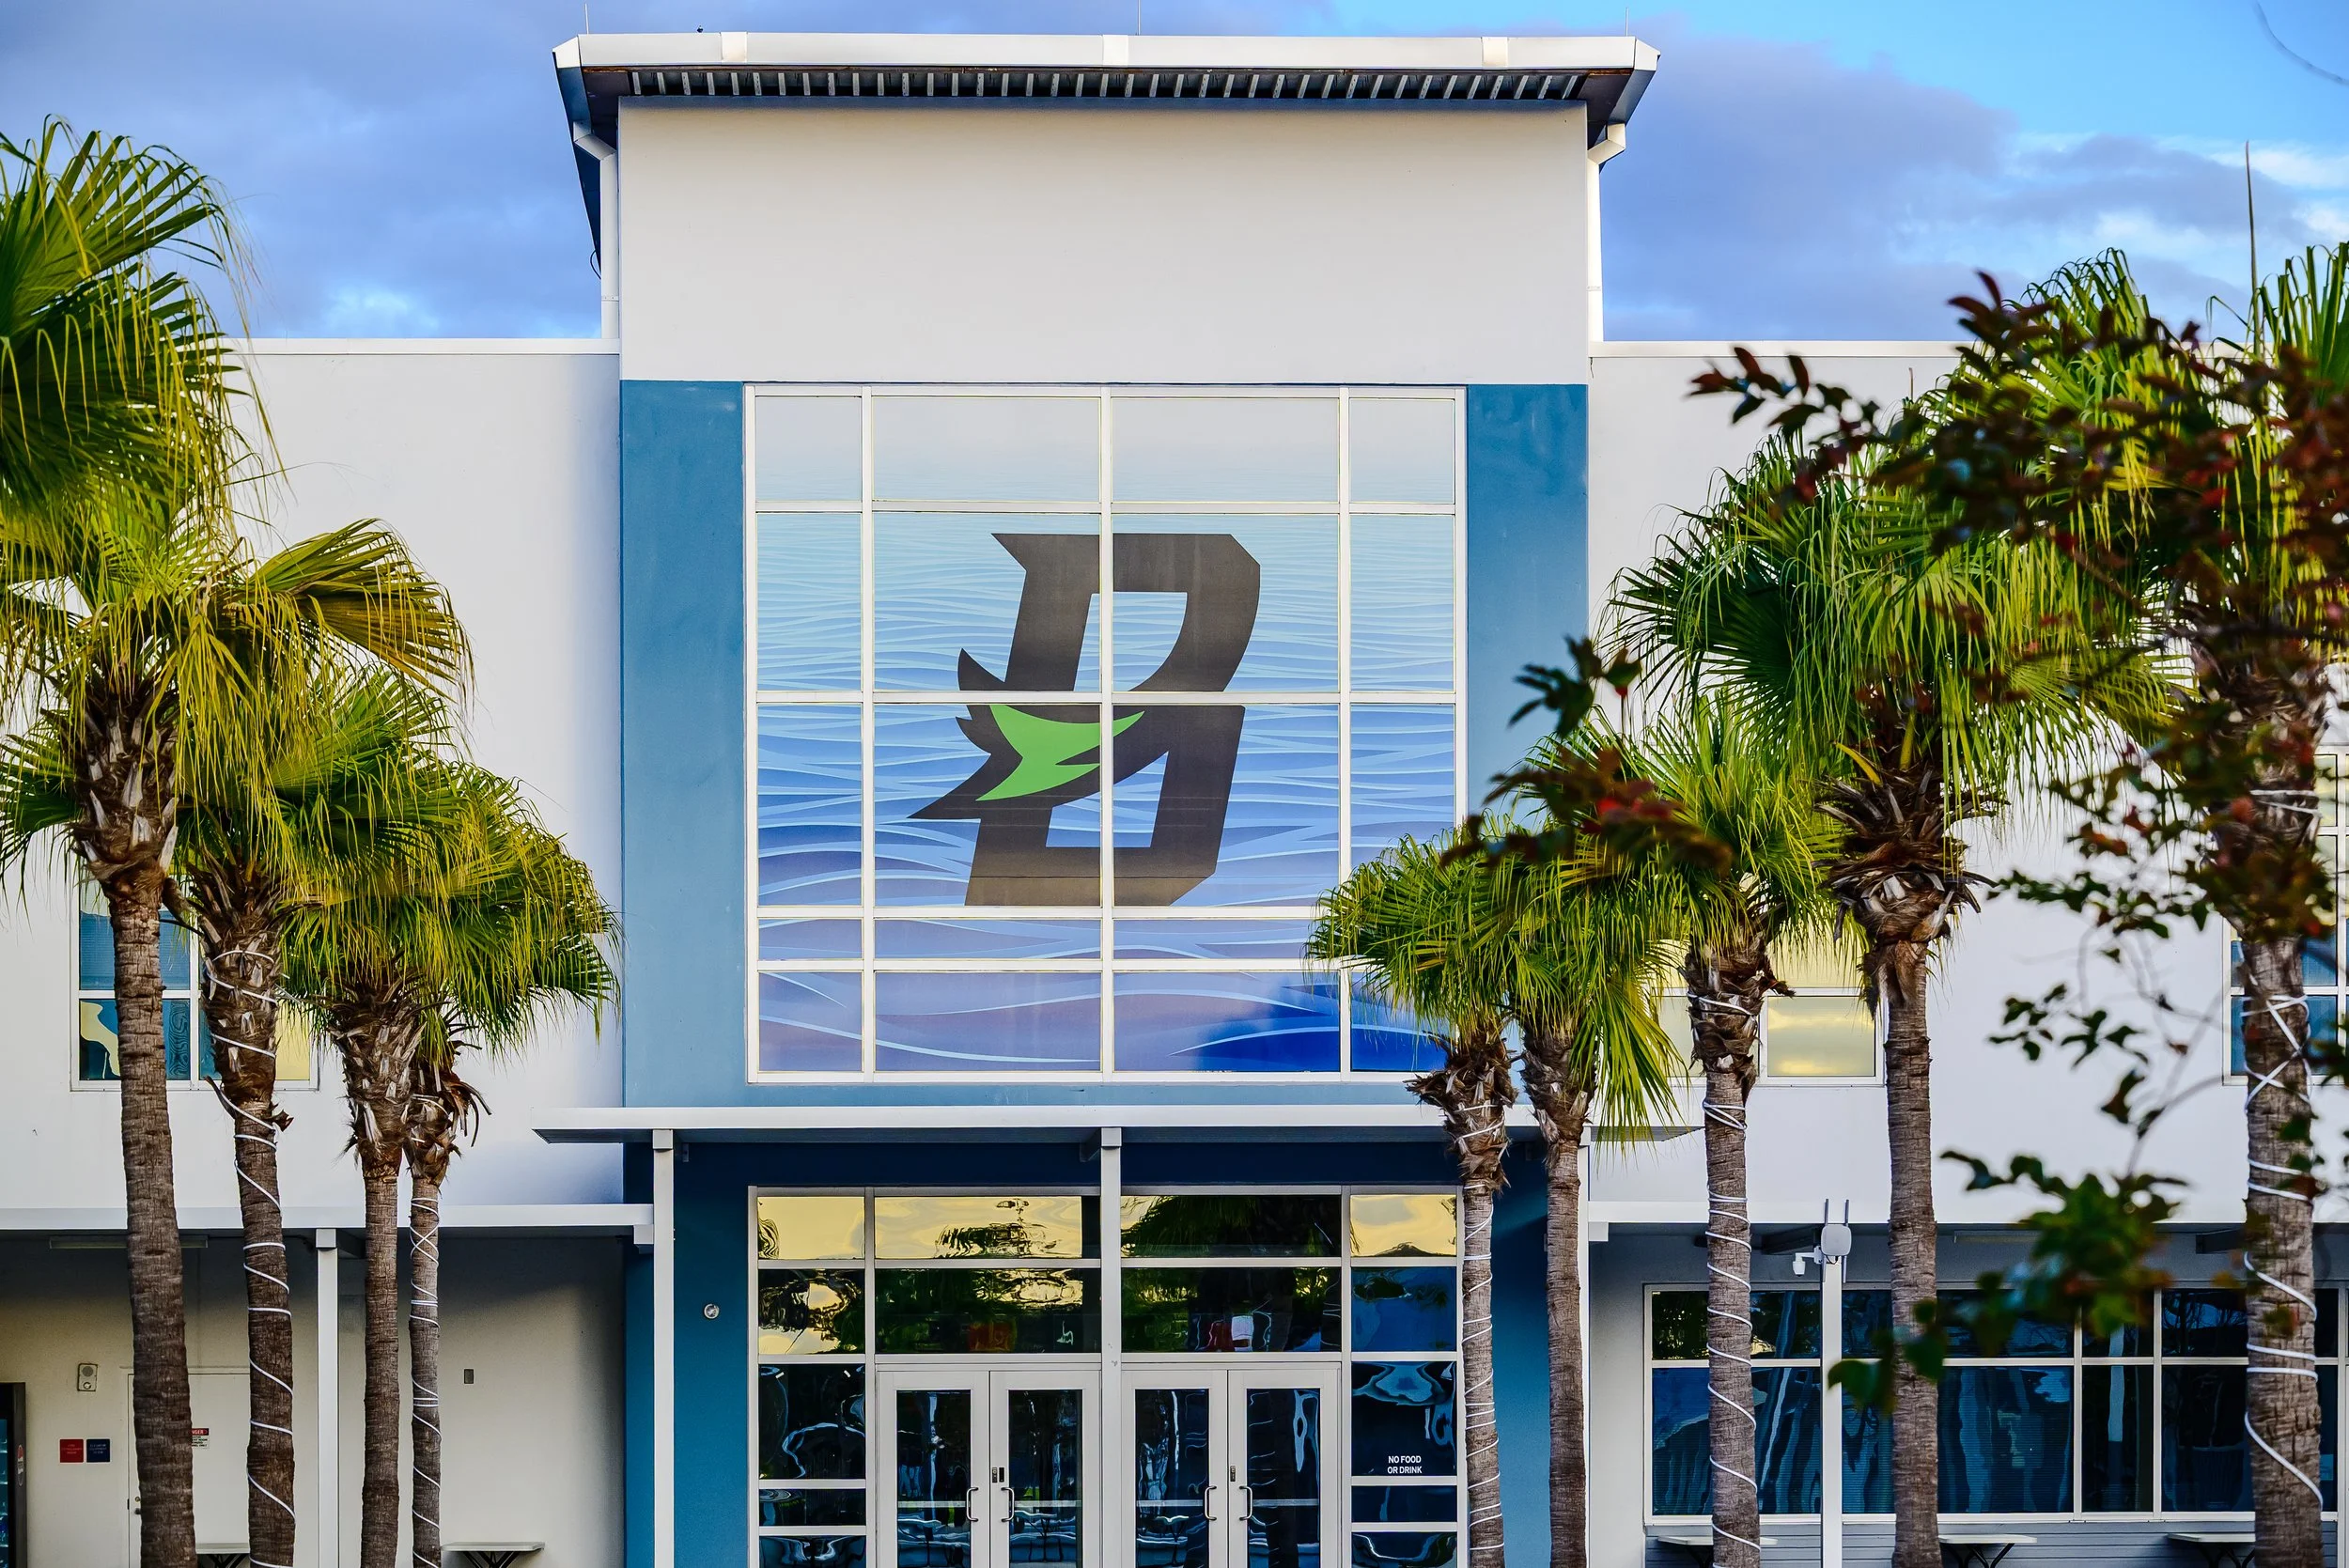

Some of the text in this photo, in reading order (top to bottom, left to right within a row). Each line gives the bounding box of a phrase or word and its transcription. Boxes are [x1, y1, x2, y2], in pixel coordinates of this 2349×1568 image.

[1389, 1455, 1422, 1464] NO FOOD
[1387, 1466, 1423, 1474] OR DRINK
